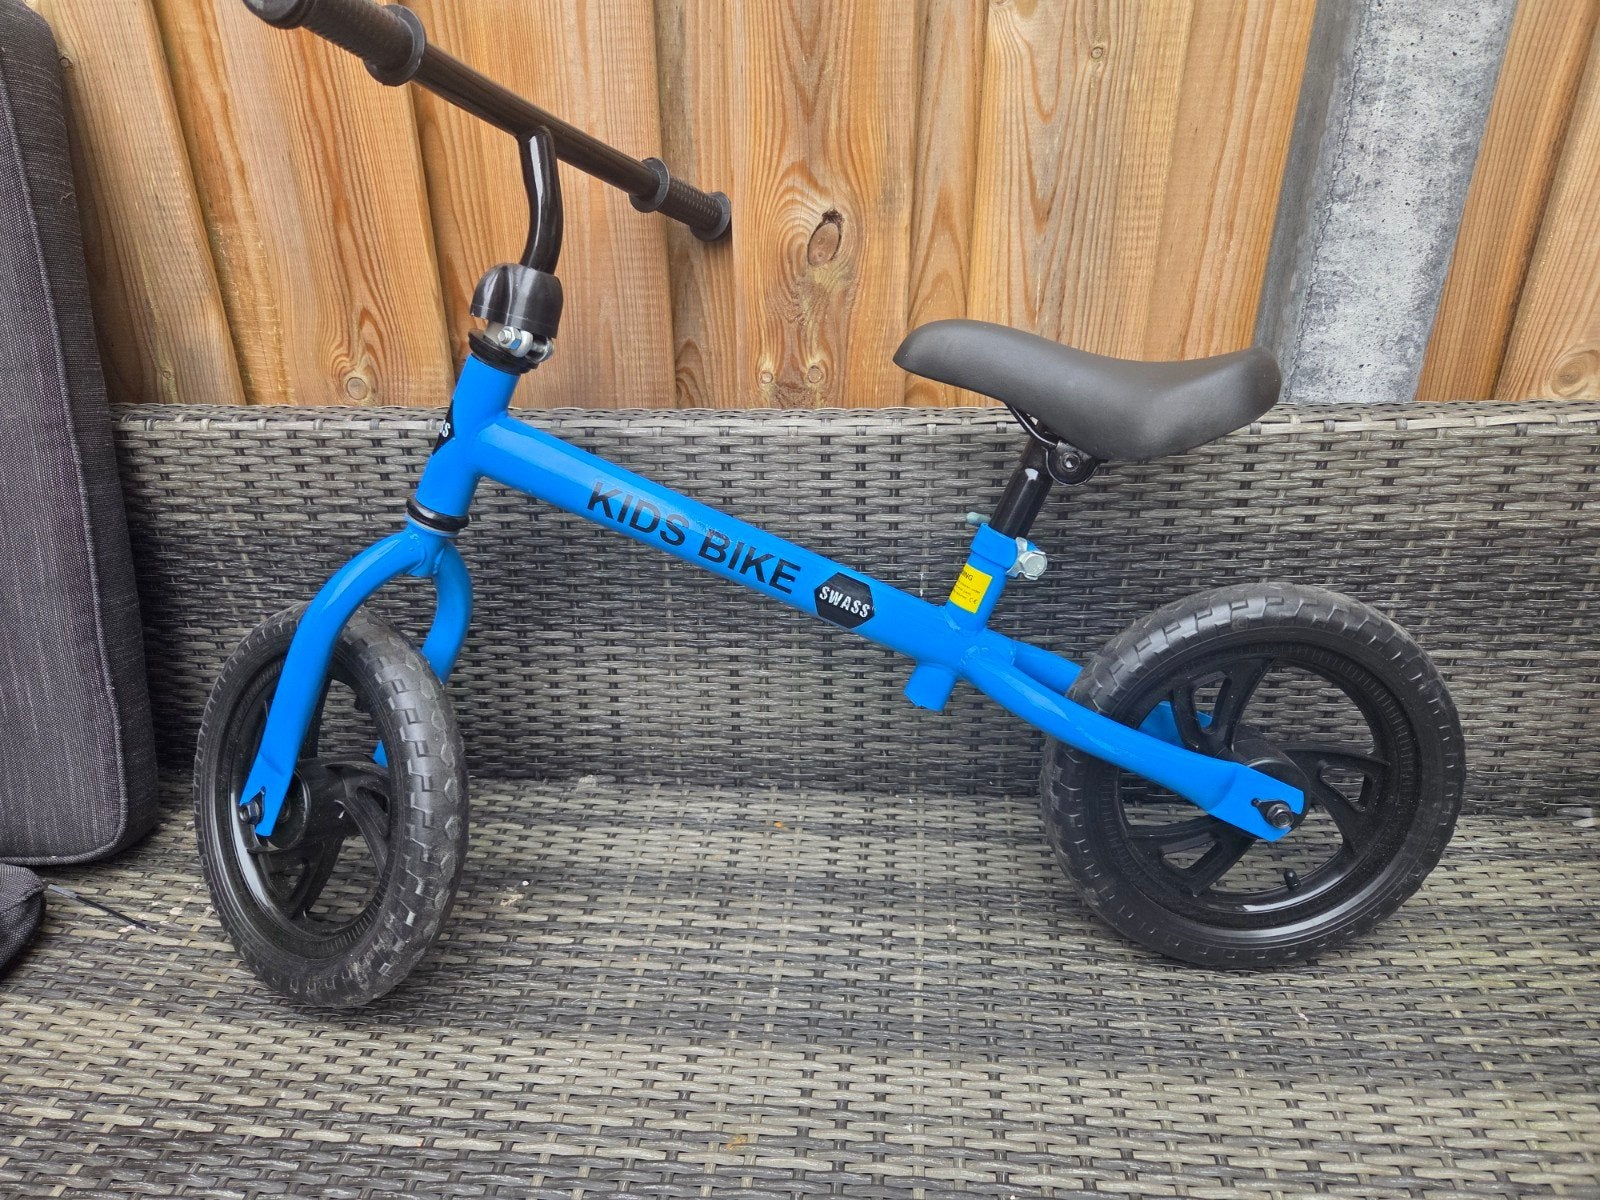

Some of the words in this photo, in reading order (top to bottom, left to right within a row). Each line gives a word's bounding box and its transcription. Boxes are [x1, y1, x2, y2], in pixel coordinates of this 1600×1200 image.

[587, 481, 689, 546] KIDS
[698, 529, 802, 594] BIKE
[819, 586, 871, 618] SWASS
